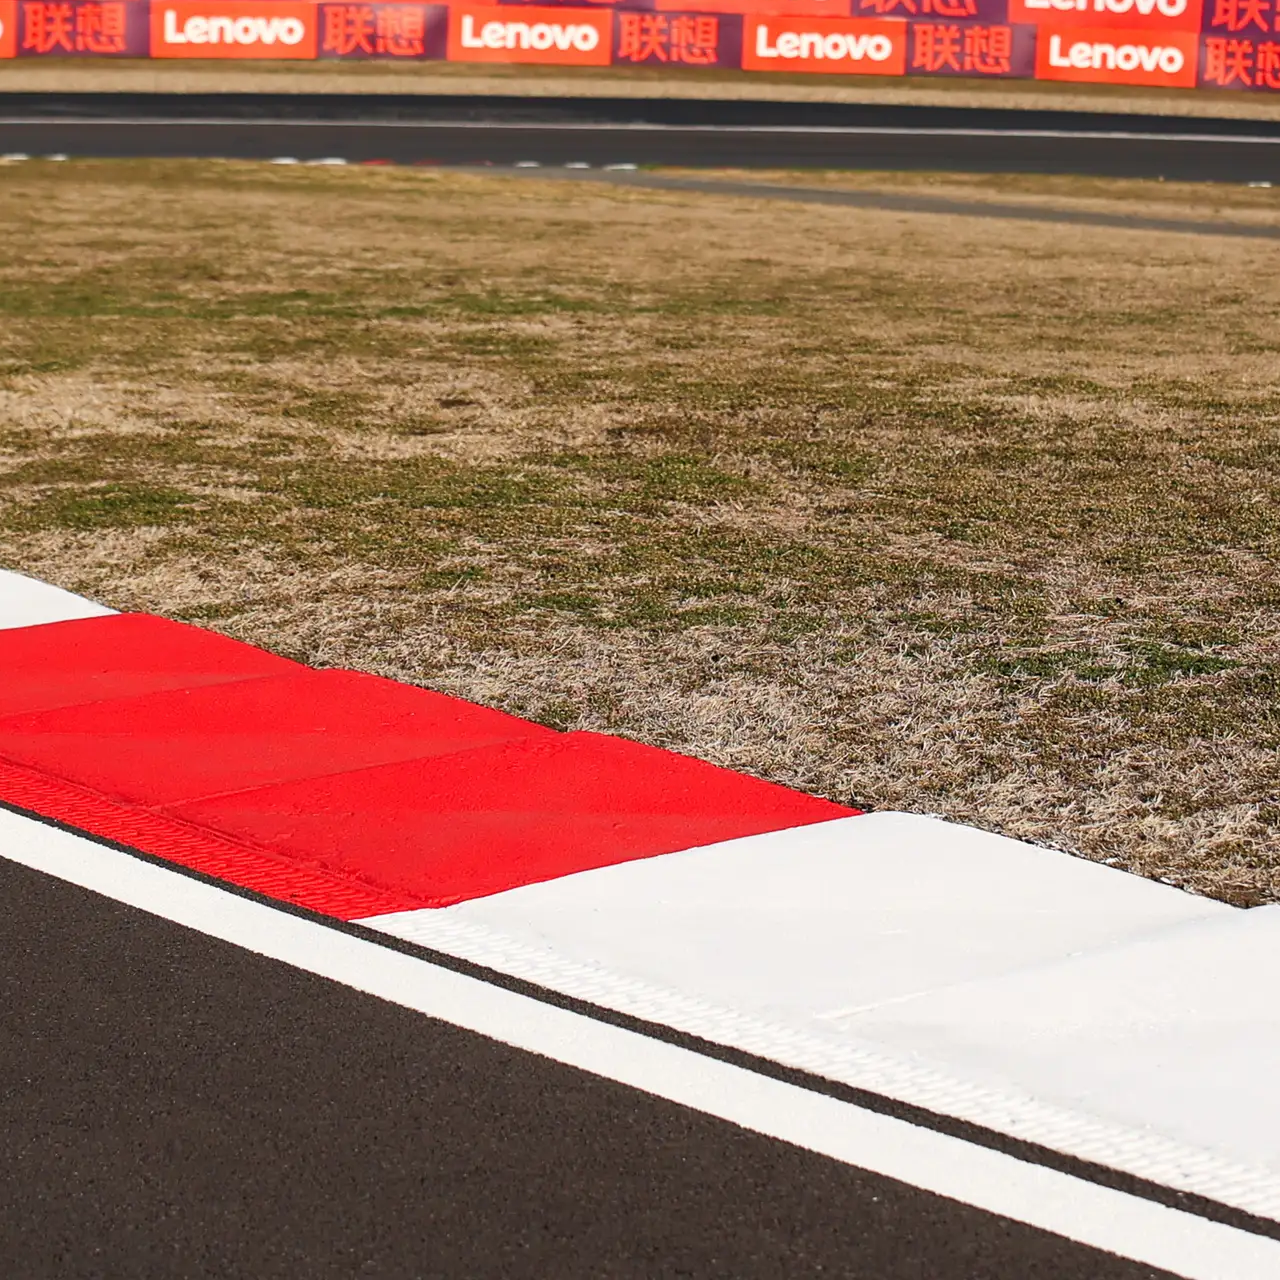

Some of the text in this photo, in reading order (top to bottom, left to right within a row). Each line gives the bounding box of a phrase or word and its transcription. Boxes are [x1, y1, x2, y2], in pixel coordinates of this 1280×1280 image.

[22, 2, 125, 54] 联想
[164, 9, 305, 45] Lenovo
[322, 4, 425, 55] 联想
[461, 14, 600, 52] Lenovo
[619, 11, 717, 65] 联想
[755, 25, 893, 61] Lenovo
[912, 24, 1012, 74] 联想
[1049, 34, 1185, 73] Lenovo
